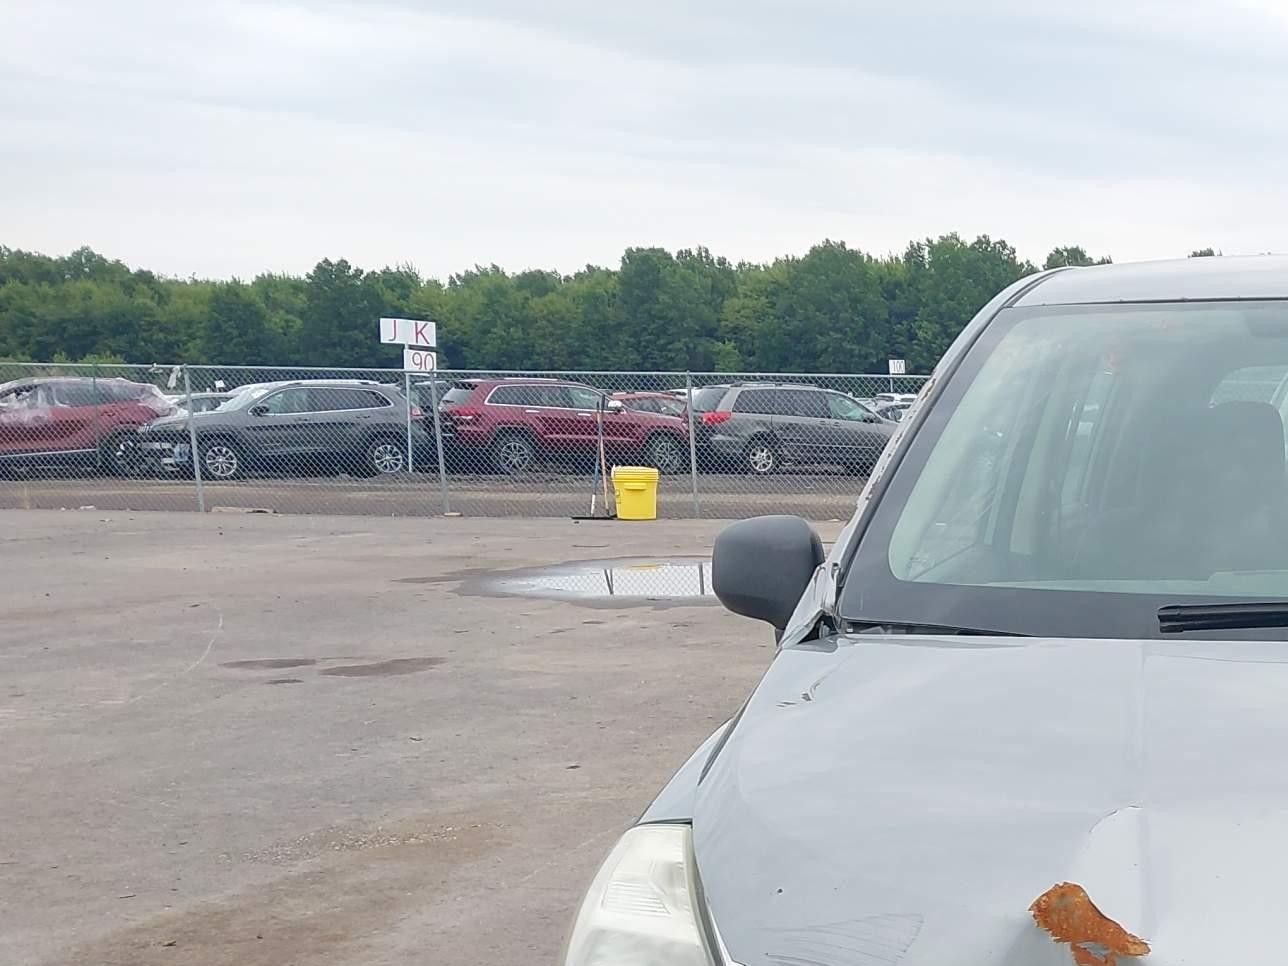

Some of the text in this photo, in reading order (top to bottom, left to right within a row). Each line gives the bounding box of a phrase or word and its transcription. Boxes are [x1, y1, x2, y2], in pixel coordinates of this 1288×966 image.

[388, 320, 430, 344] J K
[412, 352, 435, 371] 90
[892, 360, 905, 373] 100
